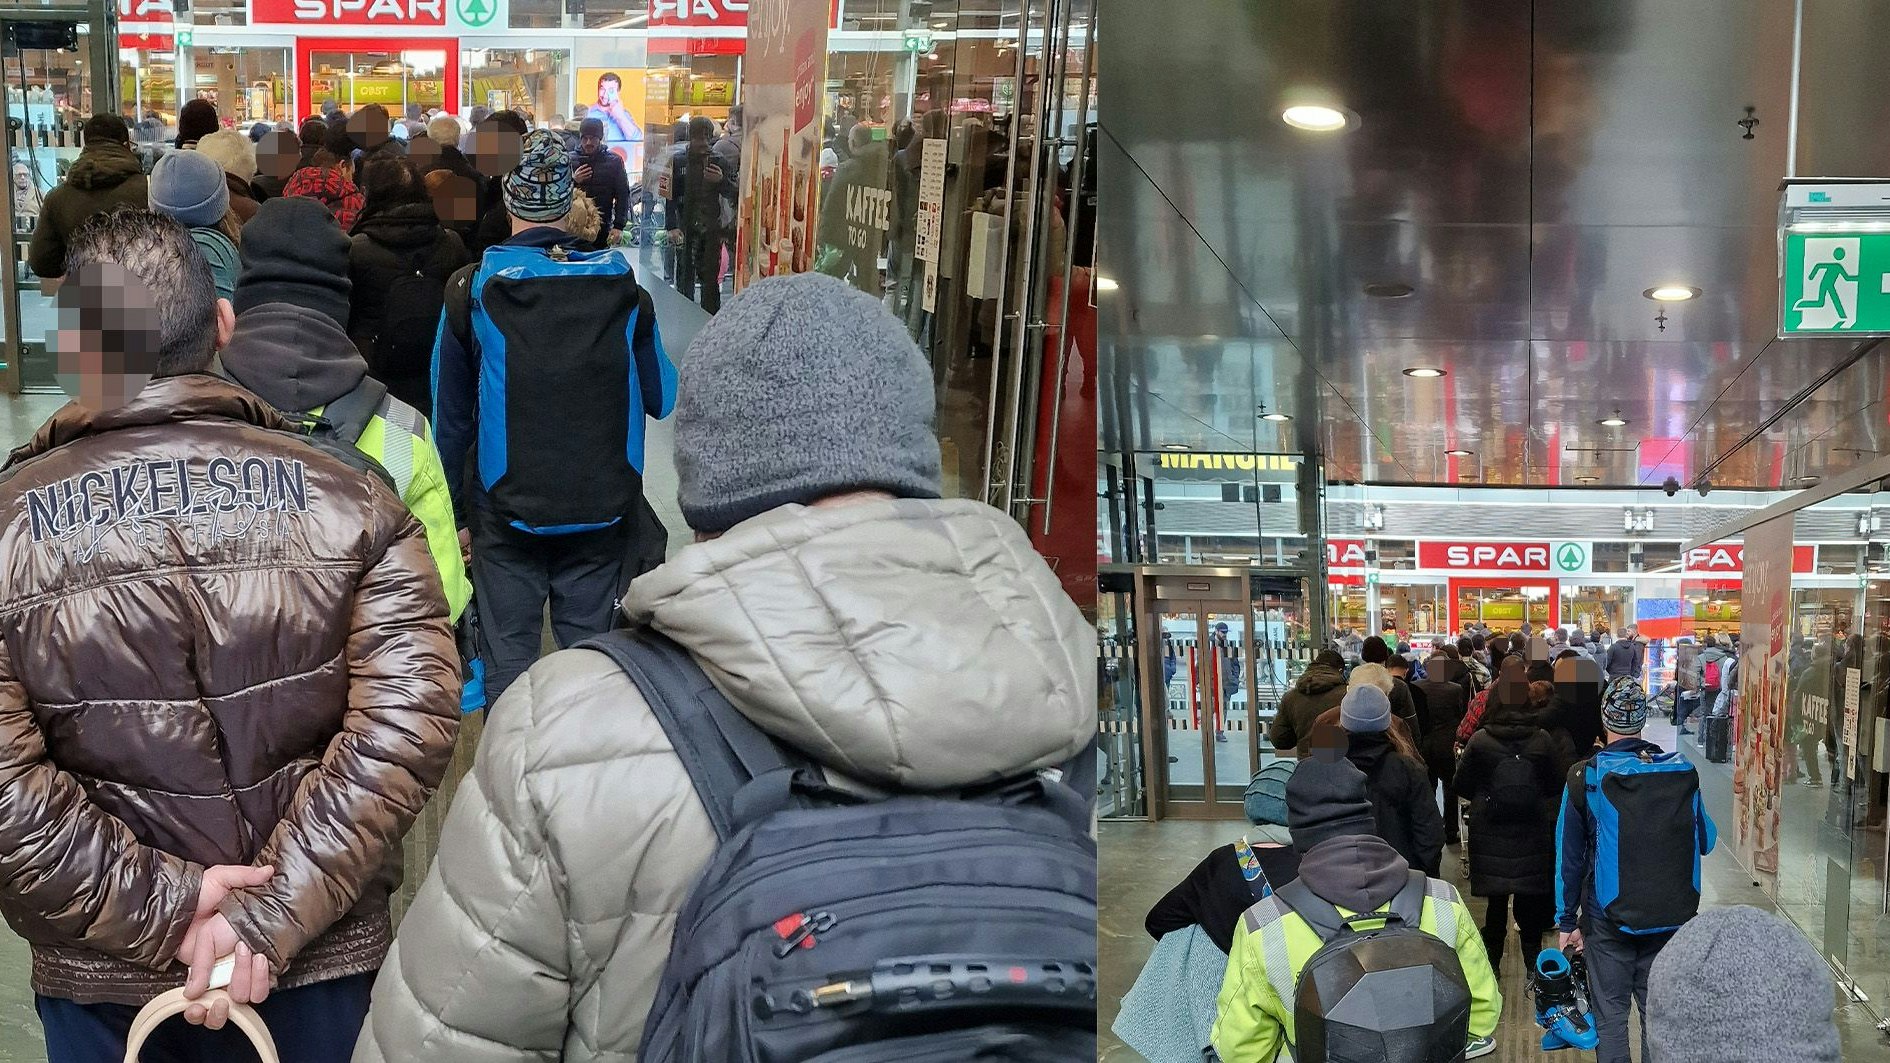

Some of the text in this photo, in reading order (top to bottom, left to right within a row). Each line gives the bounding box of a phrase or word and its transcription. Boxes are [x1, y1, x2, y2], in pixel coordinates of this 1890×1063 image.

[294, 0, 441, 19] SPAR
[360, 86, 389, 96] OBST
[845, 183, 892, 231] KAFFEE
[848, 225, 867, 249] TO GO
[25, 457, 309, 544] NICKELSON
[1447, 546, 1547, 567] SPAR
[1801, 691, 1830, 725] KAFFEE
